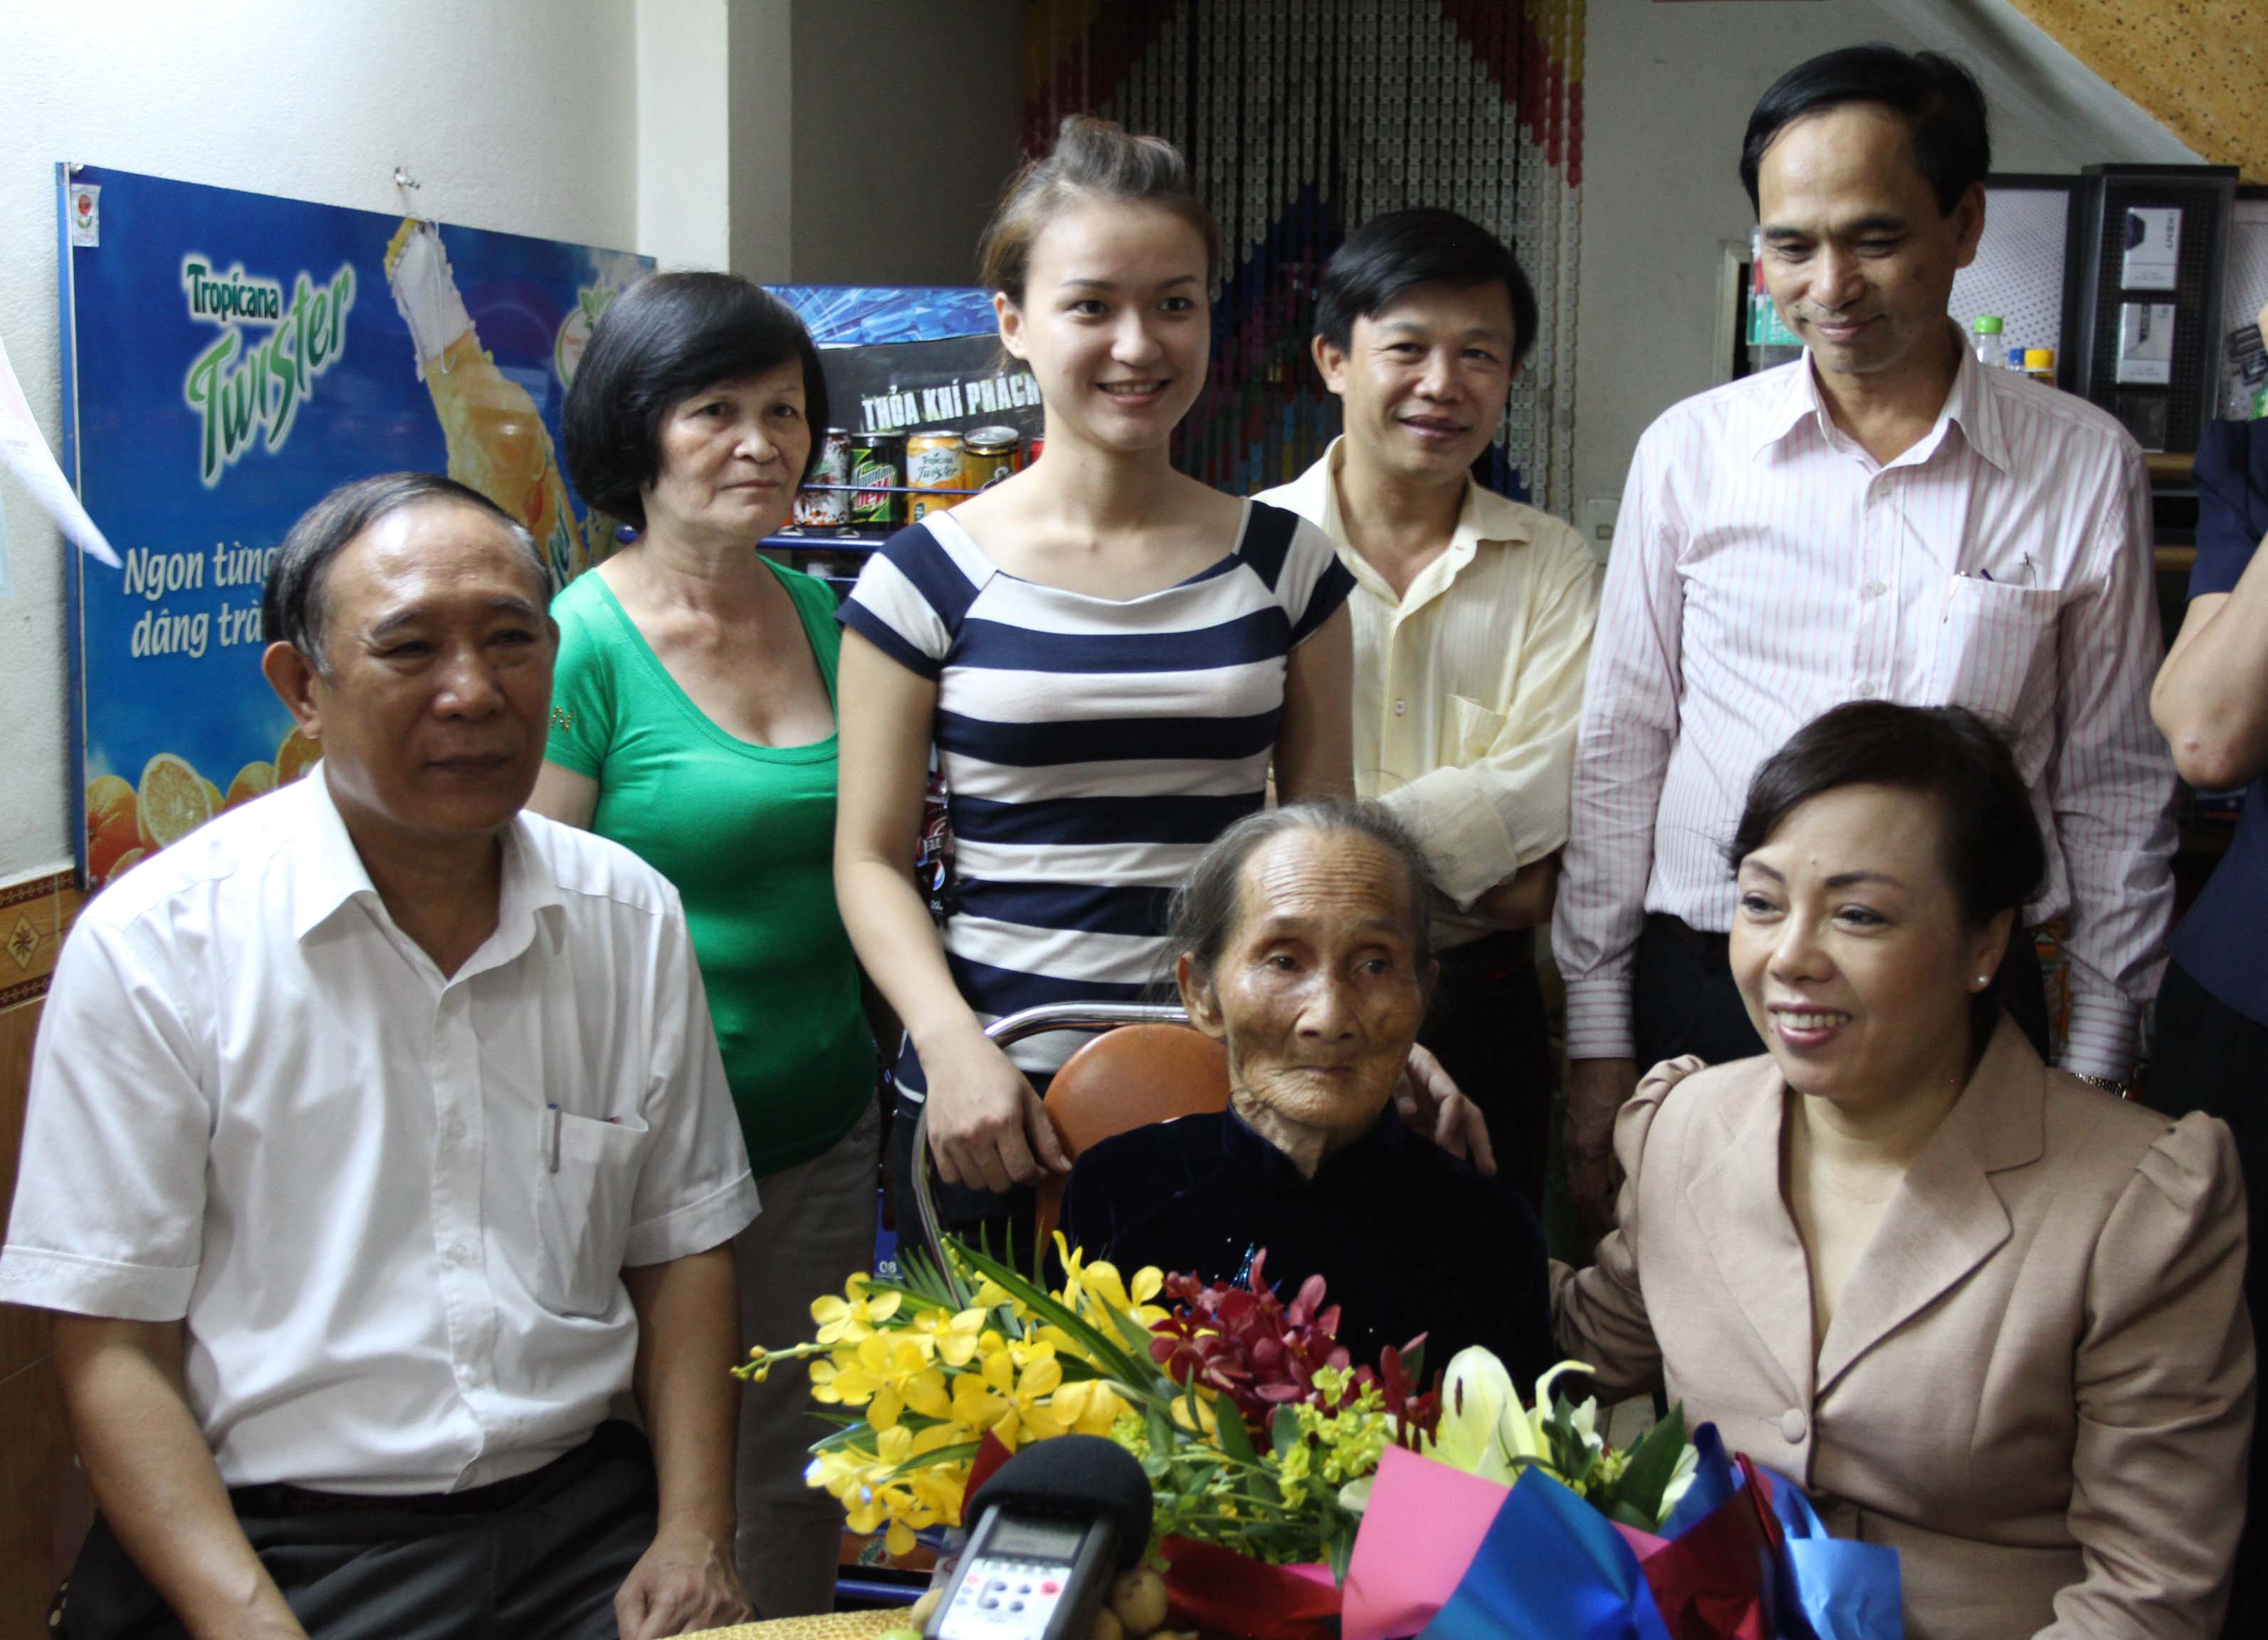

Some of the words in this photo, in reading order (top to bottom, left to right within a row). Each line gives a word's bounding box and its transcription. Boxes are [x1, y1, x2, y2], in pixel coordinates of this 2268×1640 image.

[2165, 216, 2175, 249] KENT
[188, 263, 279, 322] Tropicana
[188, 268, 350, 479] Twister
[923, 378, 964, 422] KHÍ
[918, 466, 957, 481] Twister
[123, 547, 205, 601] Ngon
[131, 608, 210, 659] dâng
